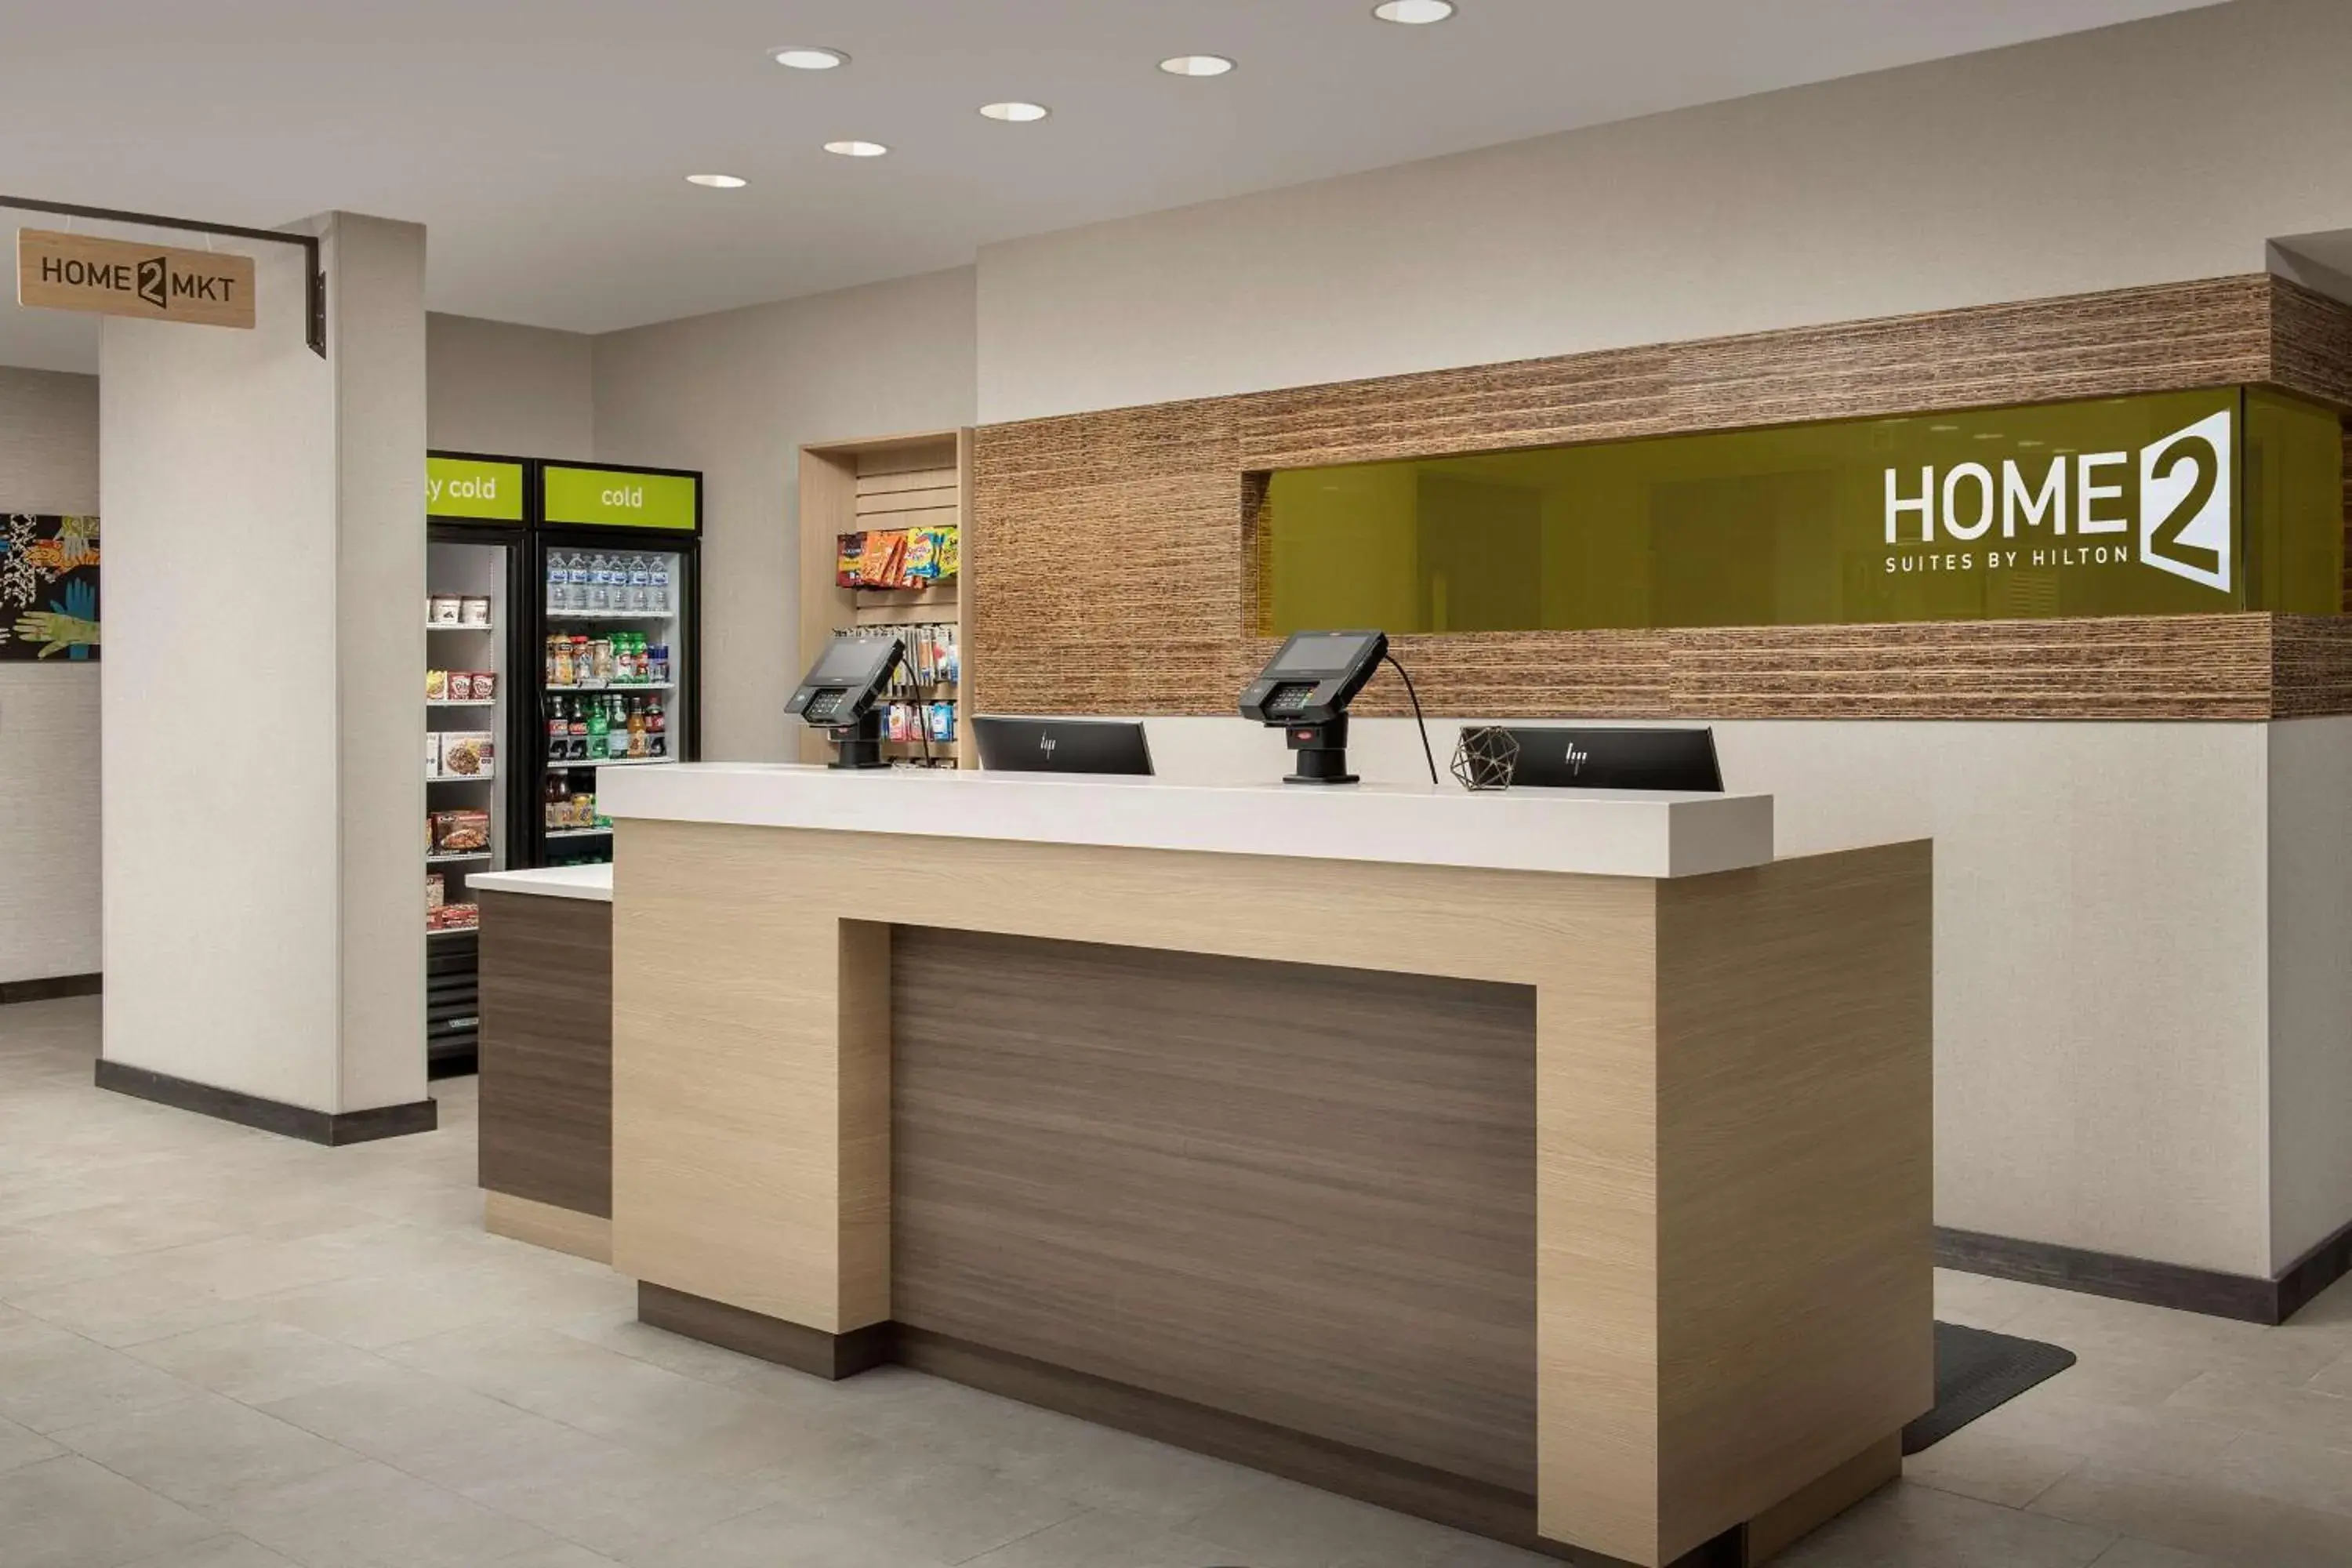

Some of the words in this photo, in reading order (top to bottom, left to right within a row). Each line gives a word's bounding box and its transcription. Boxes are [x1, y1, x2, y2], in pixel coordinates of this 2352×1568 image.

[449, 476, 496, 499] cold
[601, 487, 643, 508] cold
[1886, 553, 1973, 573] SUITES
[1988, 551, 2016, 568] BY
[2033, 546, 2129, 566] HILTON
